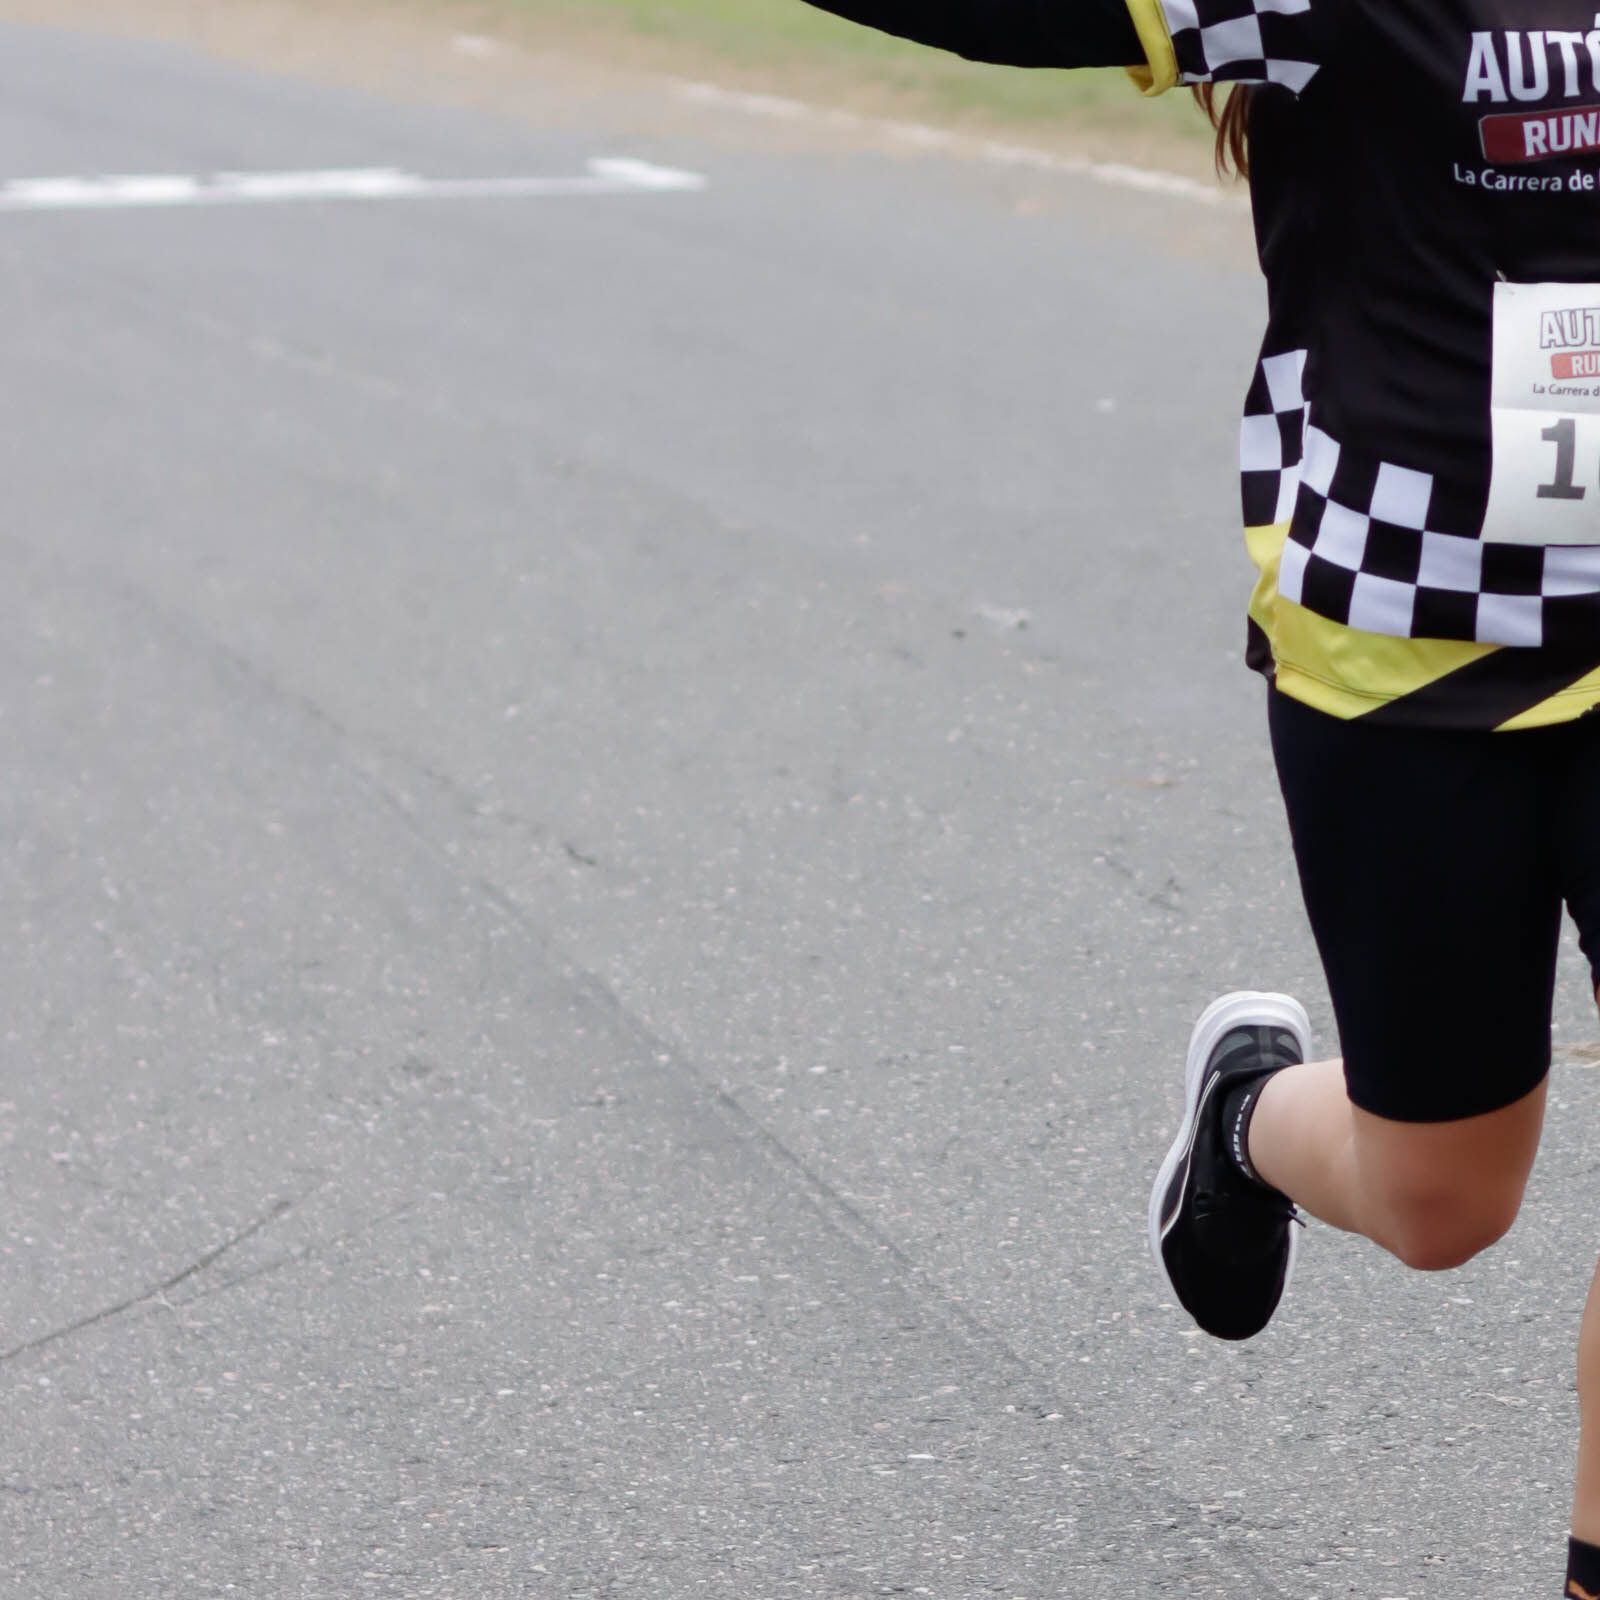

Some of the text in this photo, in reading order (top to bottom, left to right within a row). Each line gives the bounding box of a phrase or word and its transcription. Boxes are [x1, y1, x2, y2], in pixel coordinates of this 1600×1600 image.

[1454, 163, 1476, 185] La
[1481, 169, 1562, 191] Carrera
[1569, 169, 1594, 191] de
[1533, 384, 1545, 394] La
[1548, 384, 1590, 397] Carrera
